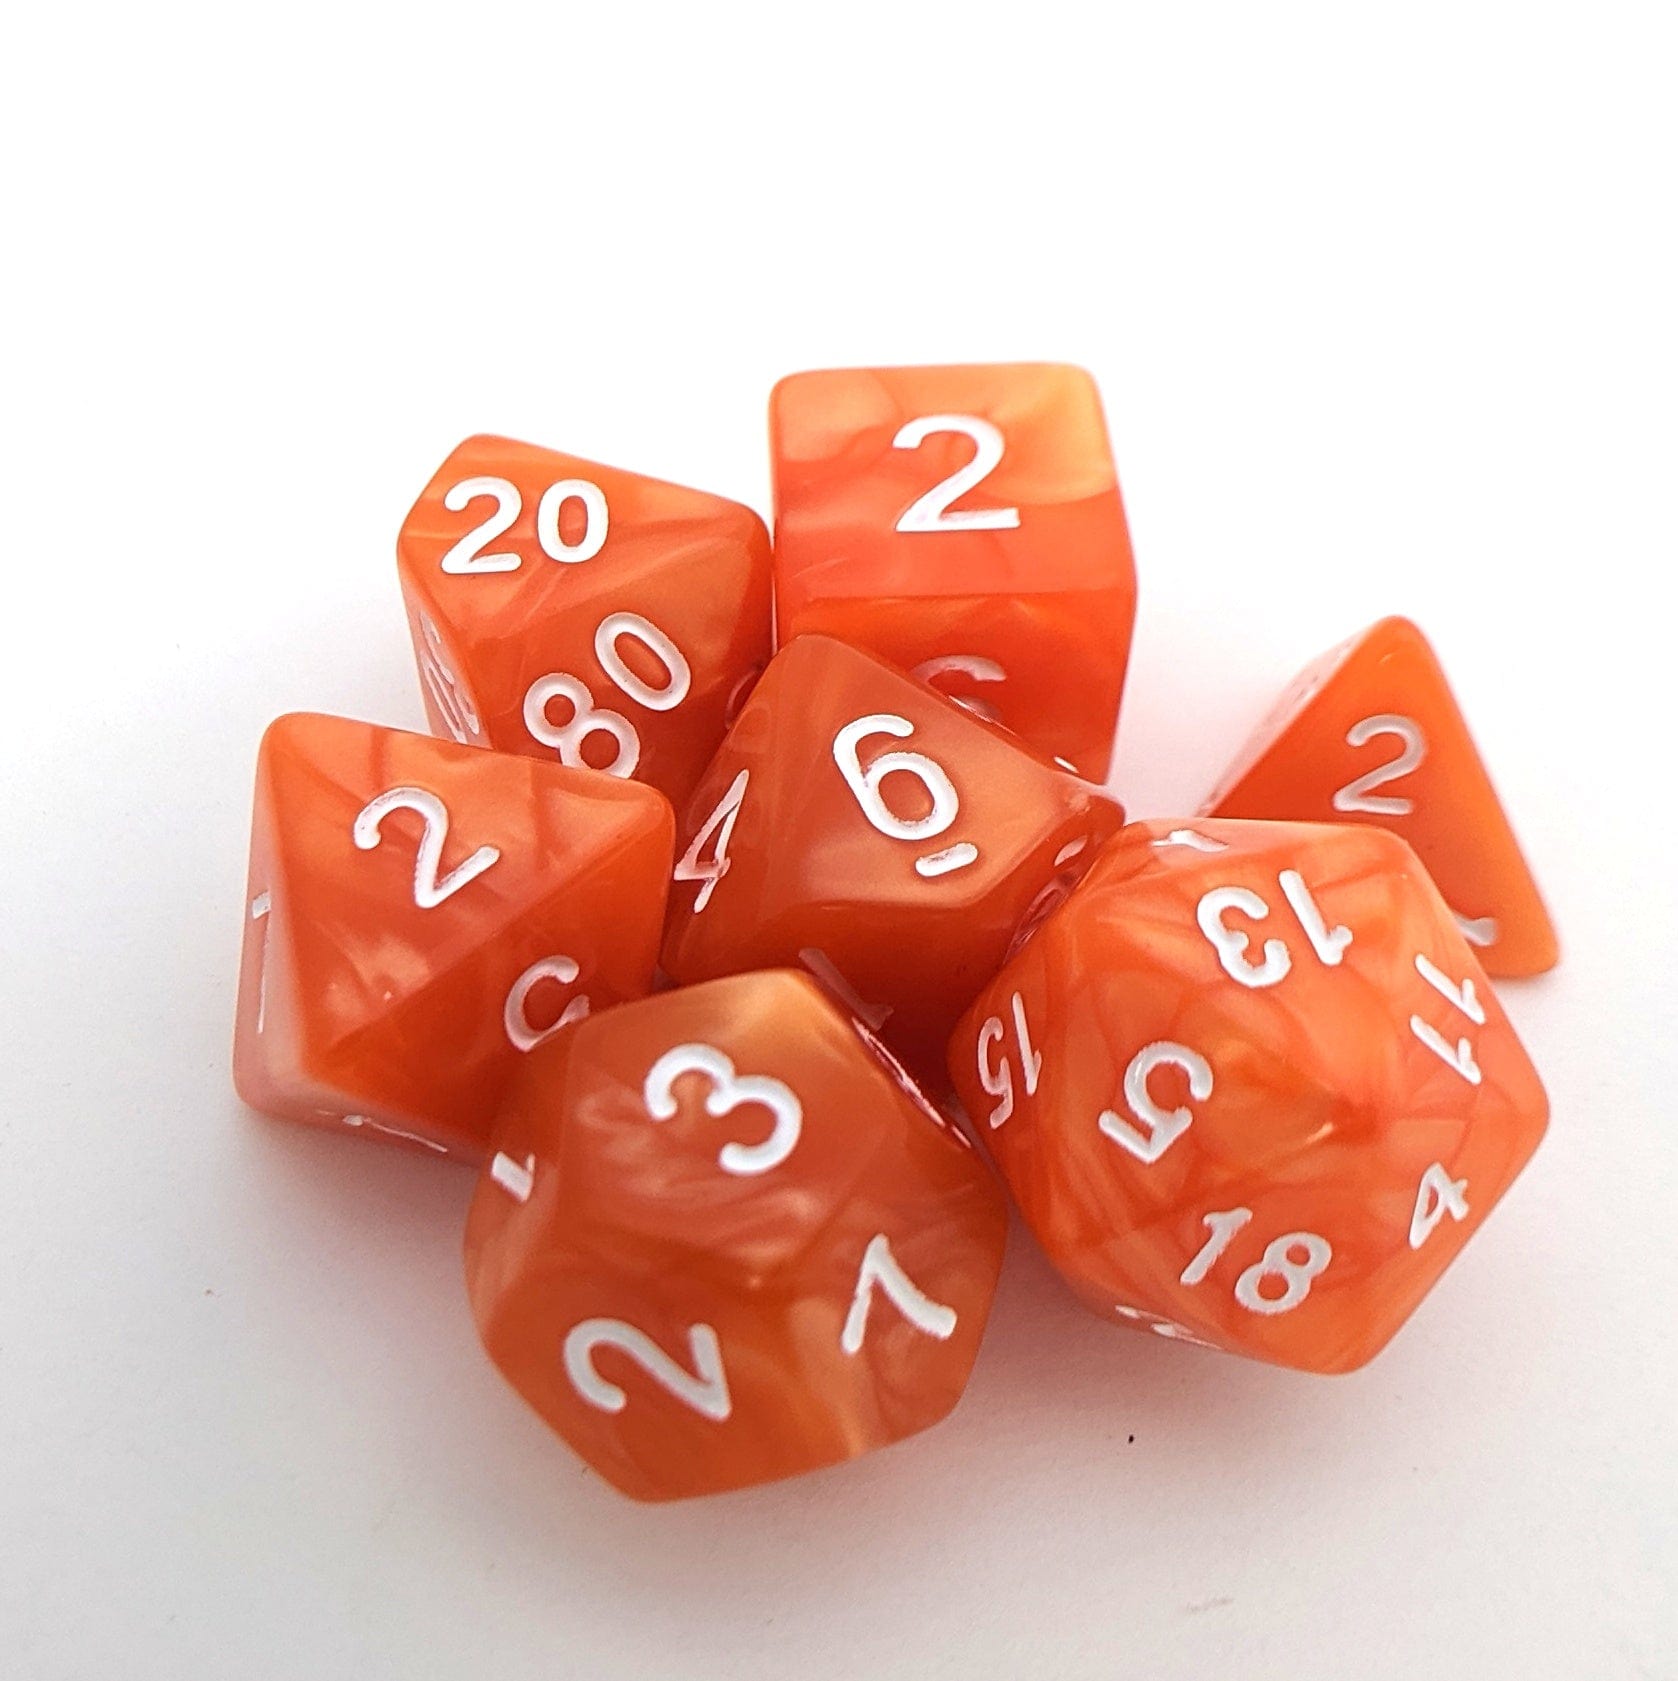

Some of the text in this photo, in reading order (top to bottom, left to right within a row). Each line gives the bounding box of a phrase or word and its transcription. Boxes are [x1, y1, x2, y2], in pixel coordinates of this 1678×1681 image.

[441, 475, 609, 574] 20
[892, 414, 1021, 532] 2
[523, 611, 692, 779] 80
[833, 714, 960, 840] 6
[1333, 713, 1429, 816] 2
[354, 786, 500, 909] 2
[674, 769, 749, 913] 4
[1197, 869, 1353, 988] 13
[977, 992, 1043, 1130] 15
[1410, 953, 1486, 1086] 11
[644, 1043, 803, 1175] 3
[1099, 1041, 1214, 1164] 5
[1180, 1207, 1332, 1314] 18
[1410, 1162, 1469, 1250] 4
[841, 1233, 957, 1354] 7
[563, 1317, 732, 1422] 2
